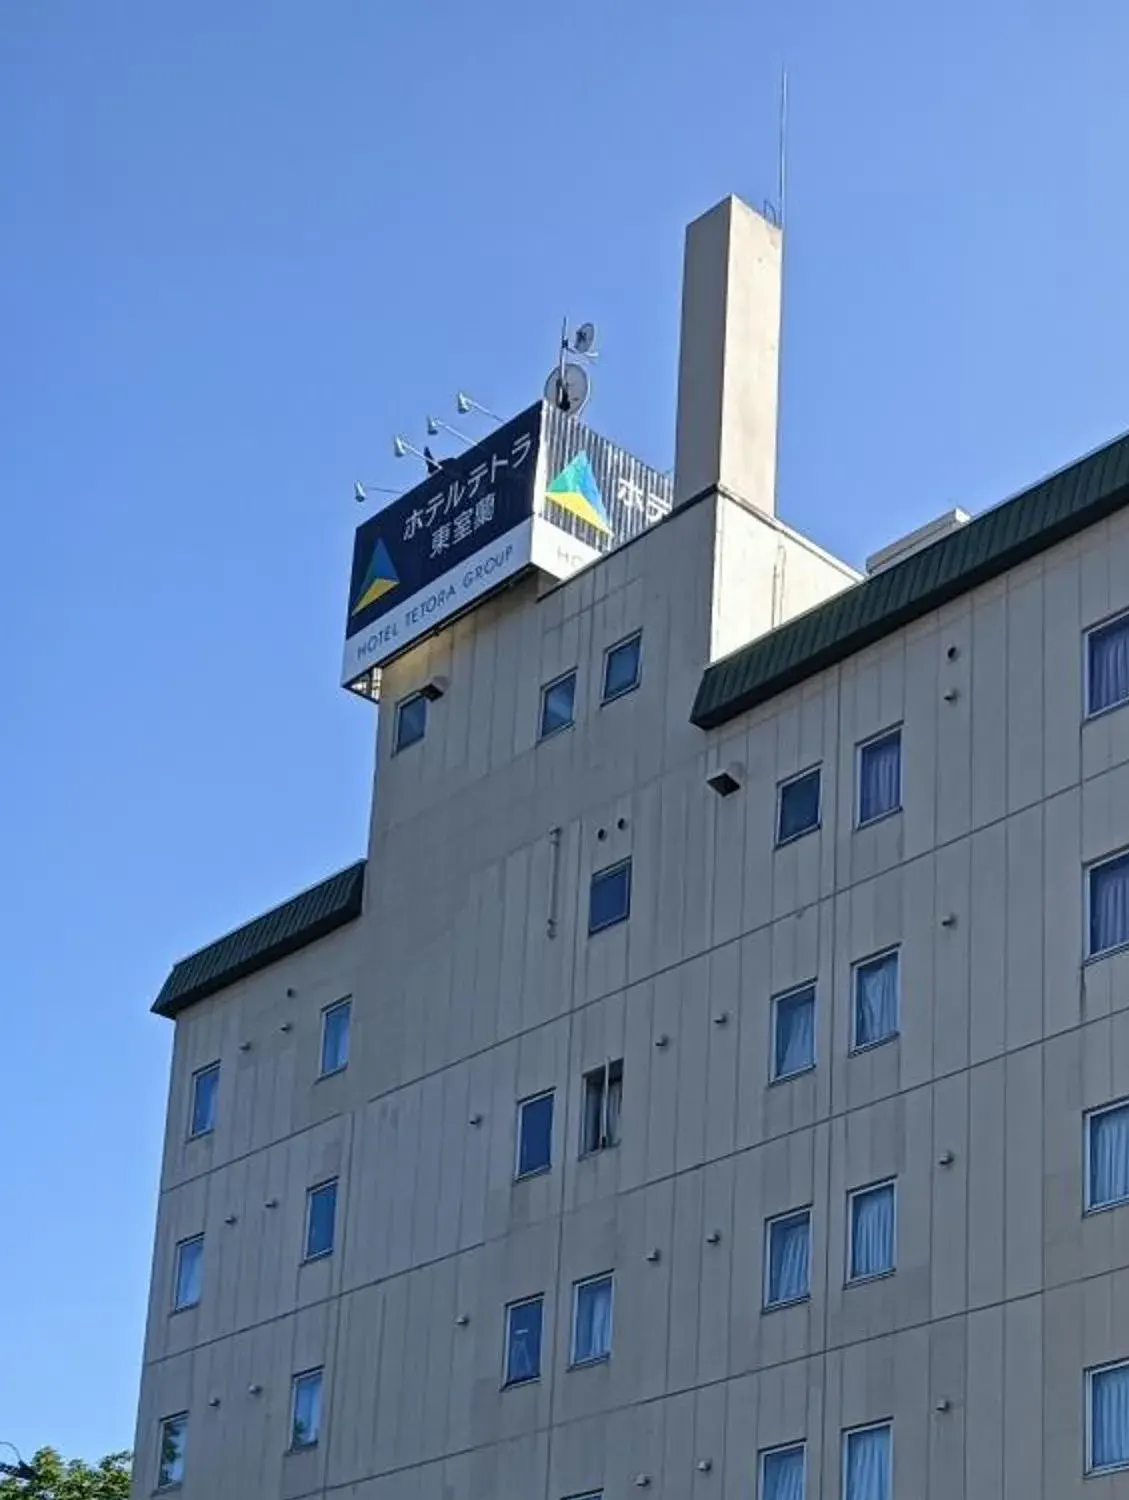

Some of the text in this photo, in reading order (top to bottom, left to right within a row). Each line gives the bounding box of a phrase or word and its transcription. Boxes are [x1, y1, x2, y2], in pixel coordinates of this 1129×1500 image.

[402, 431, 531, 541] ホテルテトラ
[430, 492, 496, 559] 東室蘭
[356, 543, 513, 661] HOTEL TETORA GROUP
